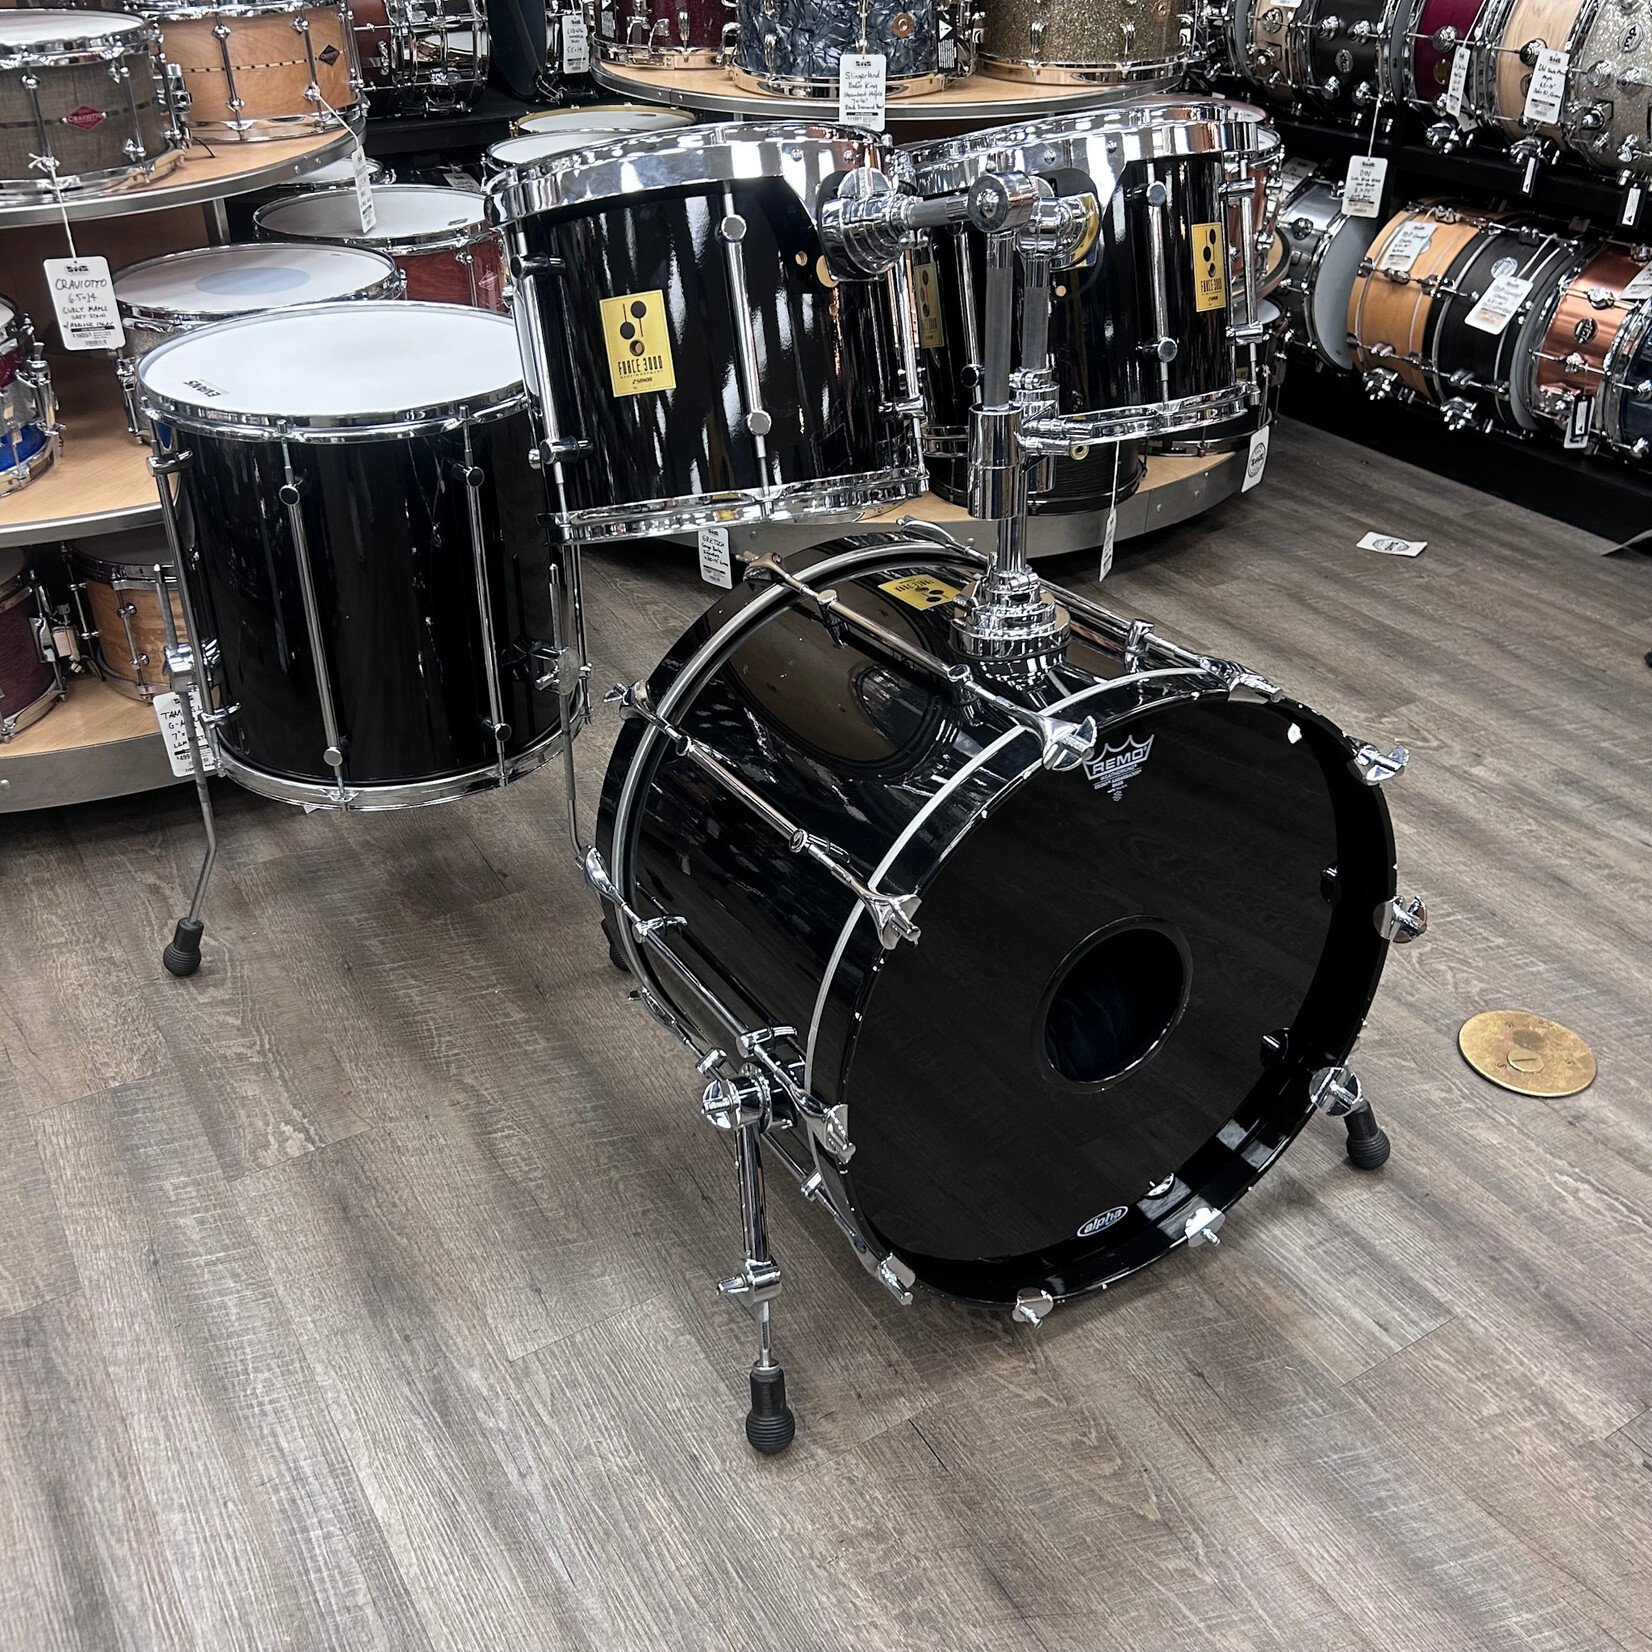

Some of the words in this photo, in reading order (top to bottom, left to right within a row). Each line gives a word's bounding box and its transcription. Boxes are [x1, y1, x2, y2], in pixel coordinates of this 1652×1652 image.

[55, 278, 108, 290] CRAVIOTTO
[63, 306, 84, 315] CURLY
[618, 358, 641, 375] FORCE
[643, 355, 663, 371] 3000
[183, 380, 222, 397] EVANS
[1084, 1209, 1122, 1234] alpha
